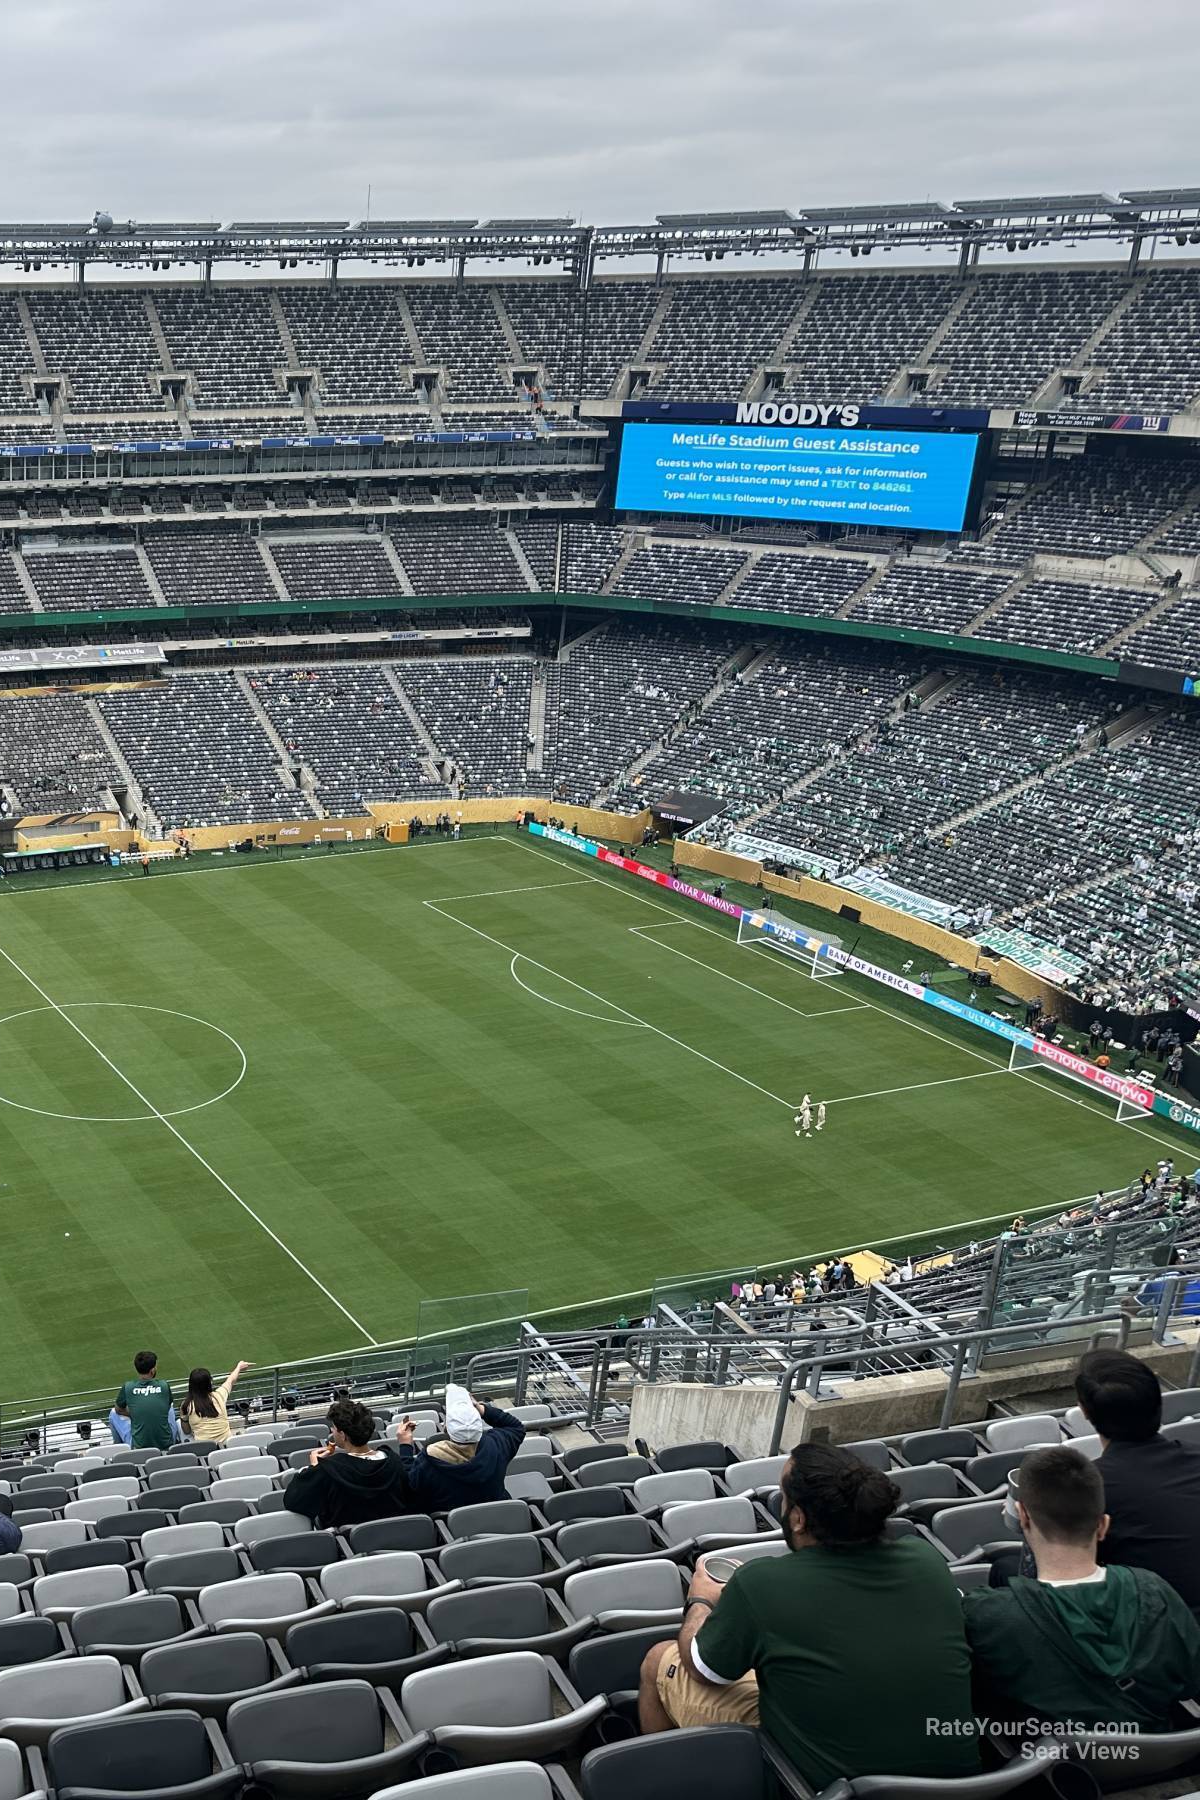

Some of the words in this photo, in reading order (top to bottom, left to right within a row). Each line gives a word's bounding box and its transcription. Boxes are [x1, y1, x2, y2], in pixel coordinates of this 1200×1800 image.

[735, 402, 860, 427] MOODY'S
[1018, 411, 1037, 419] Need
[672, 433, 727, 447] MetLife
[730, 434, 790, 449] Stadium
[793, 436, 836, 452] Guest
[839, 439, 921, 454] Assistance
[656, 458, 690, 468] Guests
[692, 460, 713, 469] who
[715, 460, 738, 470] wish
[740, 462, 751, 470] to
[754, 464, 786, 474] report
[788, 464, 823, 475] issues,
[825, 466, 842, 475] ask
[845, 466, 860, 475] for
[863, 467, 927, 479] information
[665, 472, 677, 480] or
[678, 472, 696, 481] call
[698, 473, 713, 482] for
[715, 474, 768, 485] assistance
[770, 477, 792, 487] may
[794, 478, 819, 488] send
[821, 480, 828, 488] a
[830, 480, 857, 489] TEXT
[858, 482, 870, 490] to
[663, 490, 685, 500] Type
[687, 492, 710, 500] Alert
[712, 493, 732, 501] MLS
[733, 493, 775, 504] followed
[777, 496, 789, 506] by
[790, 497, 807, 506] the
[808, 499, 846, 509] request
[848, 500, 867, 510] and
[868, 501, 913, 513] location.
[112, 648, 145, 658] MetLife
[542, 825, 587, 852] Hisense
[744, 837, 784, 851] MAIOR
[672, 879, 699, 899] QATAR
[700, 891, 736, 914] AIRWAYS
[773, 923, 797, 942] VISA
[828, 948, 853, 965] BANK
[854, 960, 867, 973] OF
[867, 965, 910, 992] AMERICA
[967, 1011, 997, 1029] ULTRA
[1037, 1042, 1088, 1074] Lenovo
[1094, 1070, 1148, 1104] Lenovo
